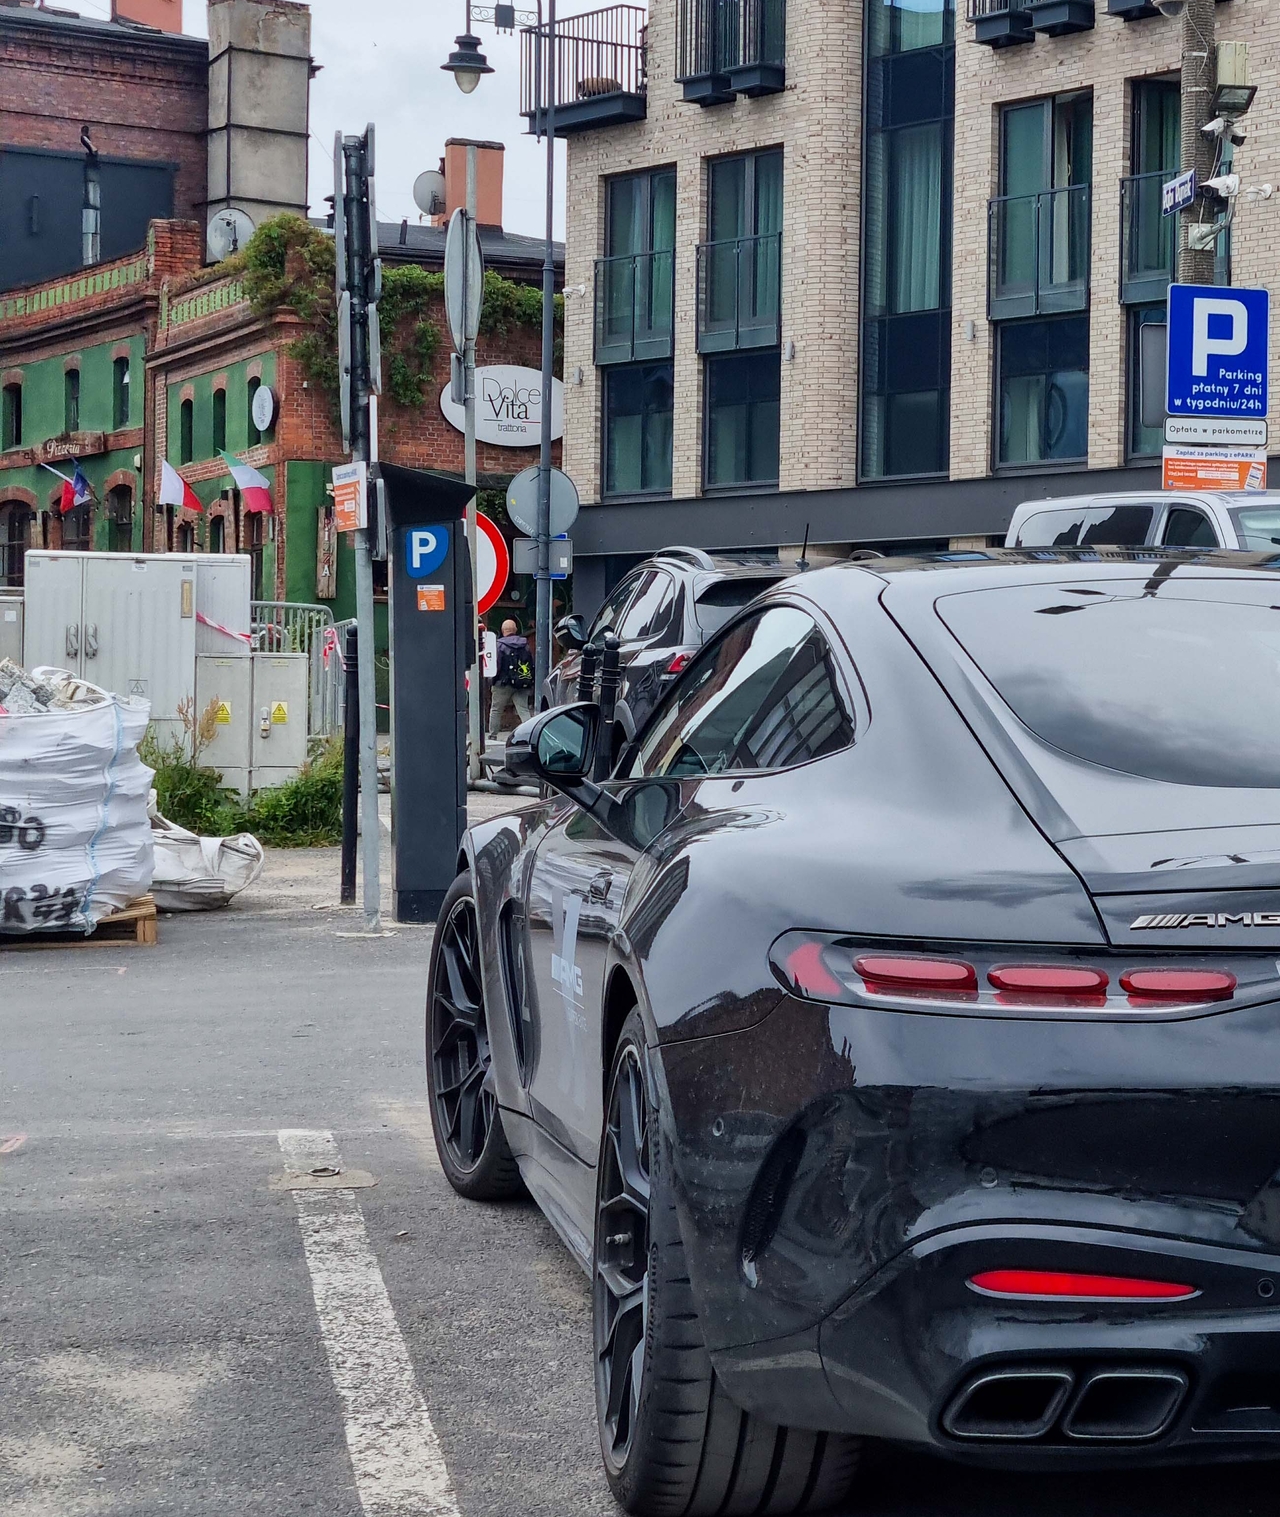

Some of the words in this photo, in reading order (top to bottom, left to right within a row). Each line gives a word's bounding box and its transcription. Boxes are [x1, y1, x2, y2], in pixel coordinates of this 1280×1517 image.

[1192, 297, 1248, 377] P
[1219, 368, 1262, 383] Parking
[483, 377, 541, 405] Dolce
[1192, 382, 1229, 396] płatny
[1233, 384, 1240, 394] 7
[1244, 384, 1262, 395] dni
[488, 394, 529, 419] Vita
[1174, 398, 1182, 406] w
[1187, 397, 1262, 410] tygodniu/24h
[1169, 425, 1198, 434] Opłata
[1212, 427, 1263, 435] parkometrze
[412, 531, 437, 568] P
